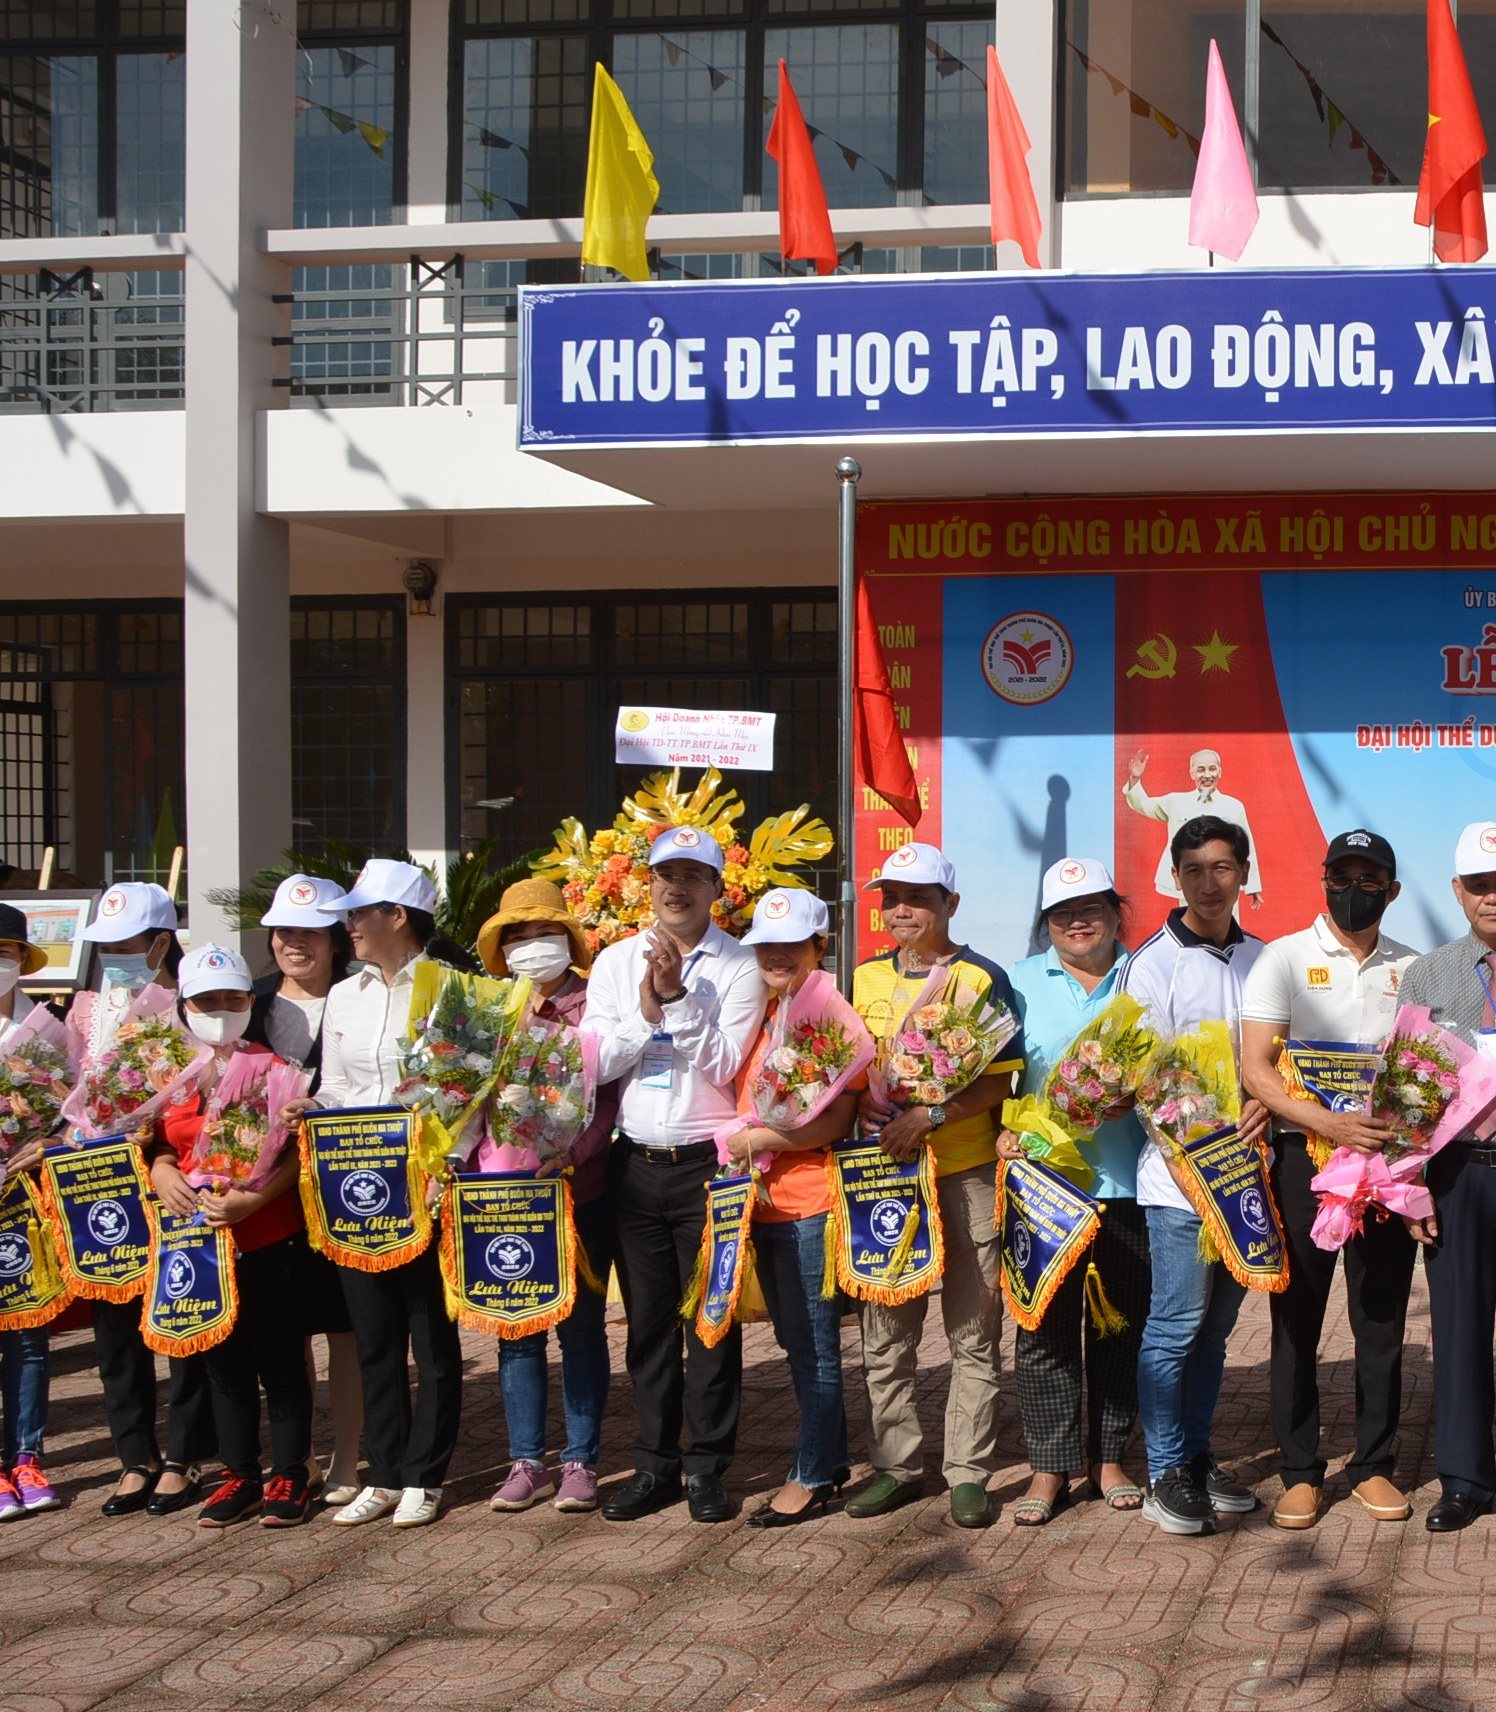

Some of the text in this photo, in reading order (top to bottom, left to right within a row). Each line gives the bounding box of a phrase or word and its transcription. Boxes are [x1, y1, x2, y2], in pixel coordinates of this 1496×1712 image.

[561, 317, 706, 403] KHỎE
[724, 308, 801, 399] ĐỂ
[817, 330, 930, 411] HỌC
[950, 315, 1066, 408] TẬP,
[1086, 325, 1192, 391] LAO
[1211, 310, 1394, 403] ĐỘNG,
[888, 515, 992, 559] NƯỚC
[1005, 513, 1110, 565] CỘNG
[1123, 510, 1202, 554] HÒA
[1214, 510, 1266, 553] XÃ
[1279, 508, 1344, 560] HỘI
[1358, 502, 1436, 551] CHỦ
[1464, 586, 1486, 608] ỦY
[878, 620, 915, 649] TOÀN
[887, 660, 911, 688] ÂN
[672, 713, 700, 723] Doanh
[1356, 724, 1391, 752] ĐẠI
[1397, 721, 1432, 752] HỘI
[1436, 715, 1476, 747] THỂ
[668, 753, 688, 762] Năm
[691, 754, 710, 763] 2021
[719, 755, 739, 765] 2022
[332, 1217, 362, 1232] Lưu
[79, 1250, 108, 1266] Lưu
[856, 1249, 885, 1265] Lưu
[469, 1280, 555, 1297] Lưu Niệm
[173, 1298, 218, 1315] Niệm
